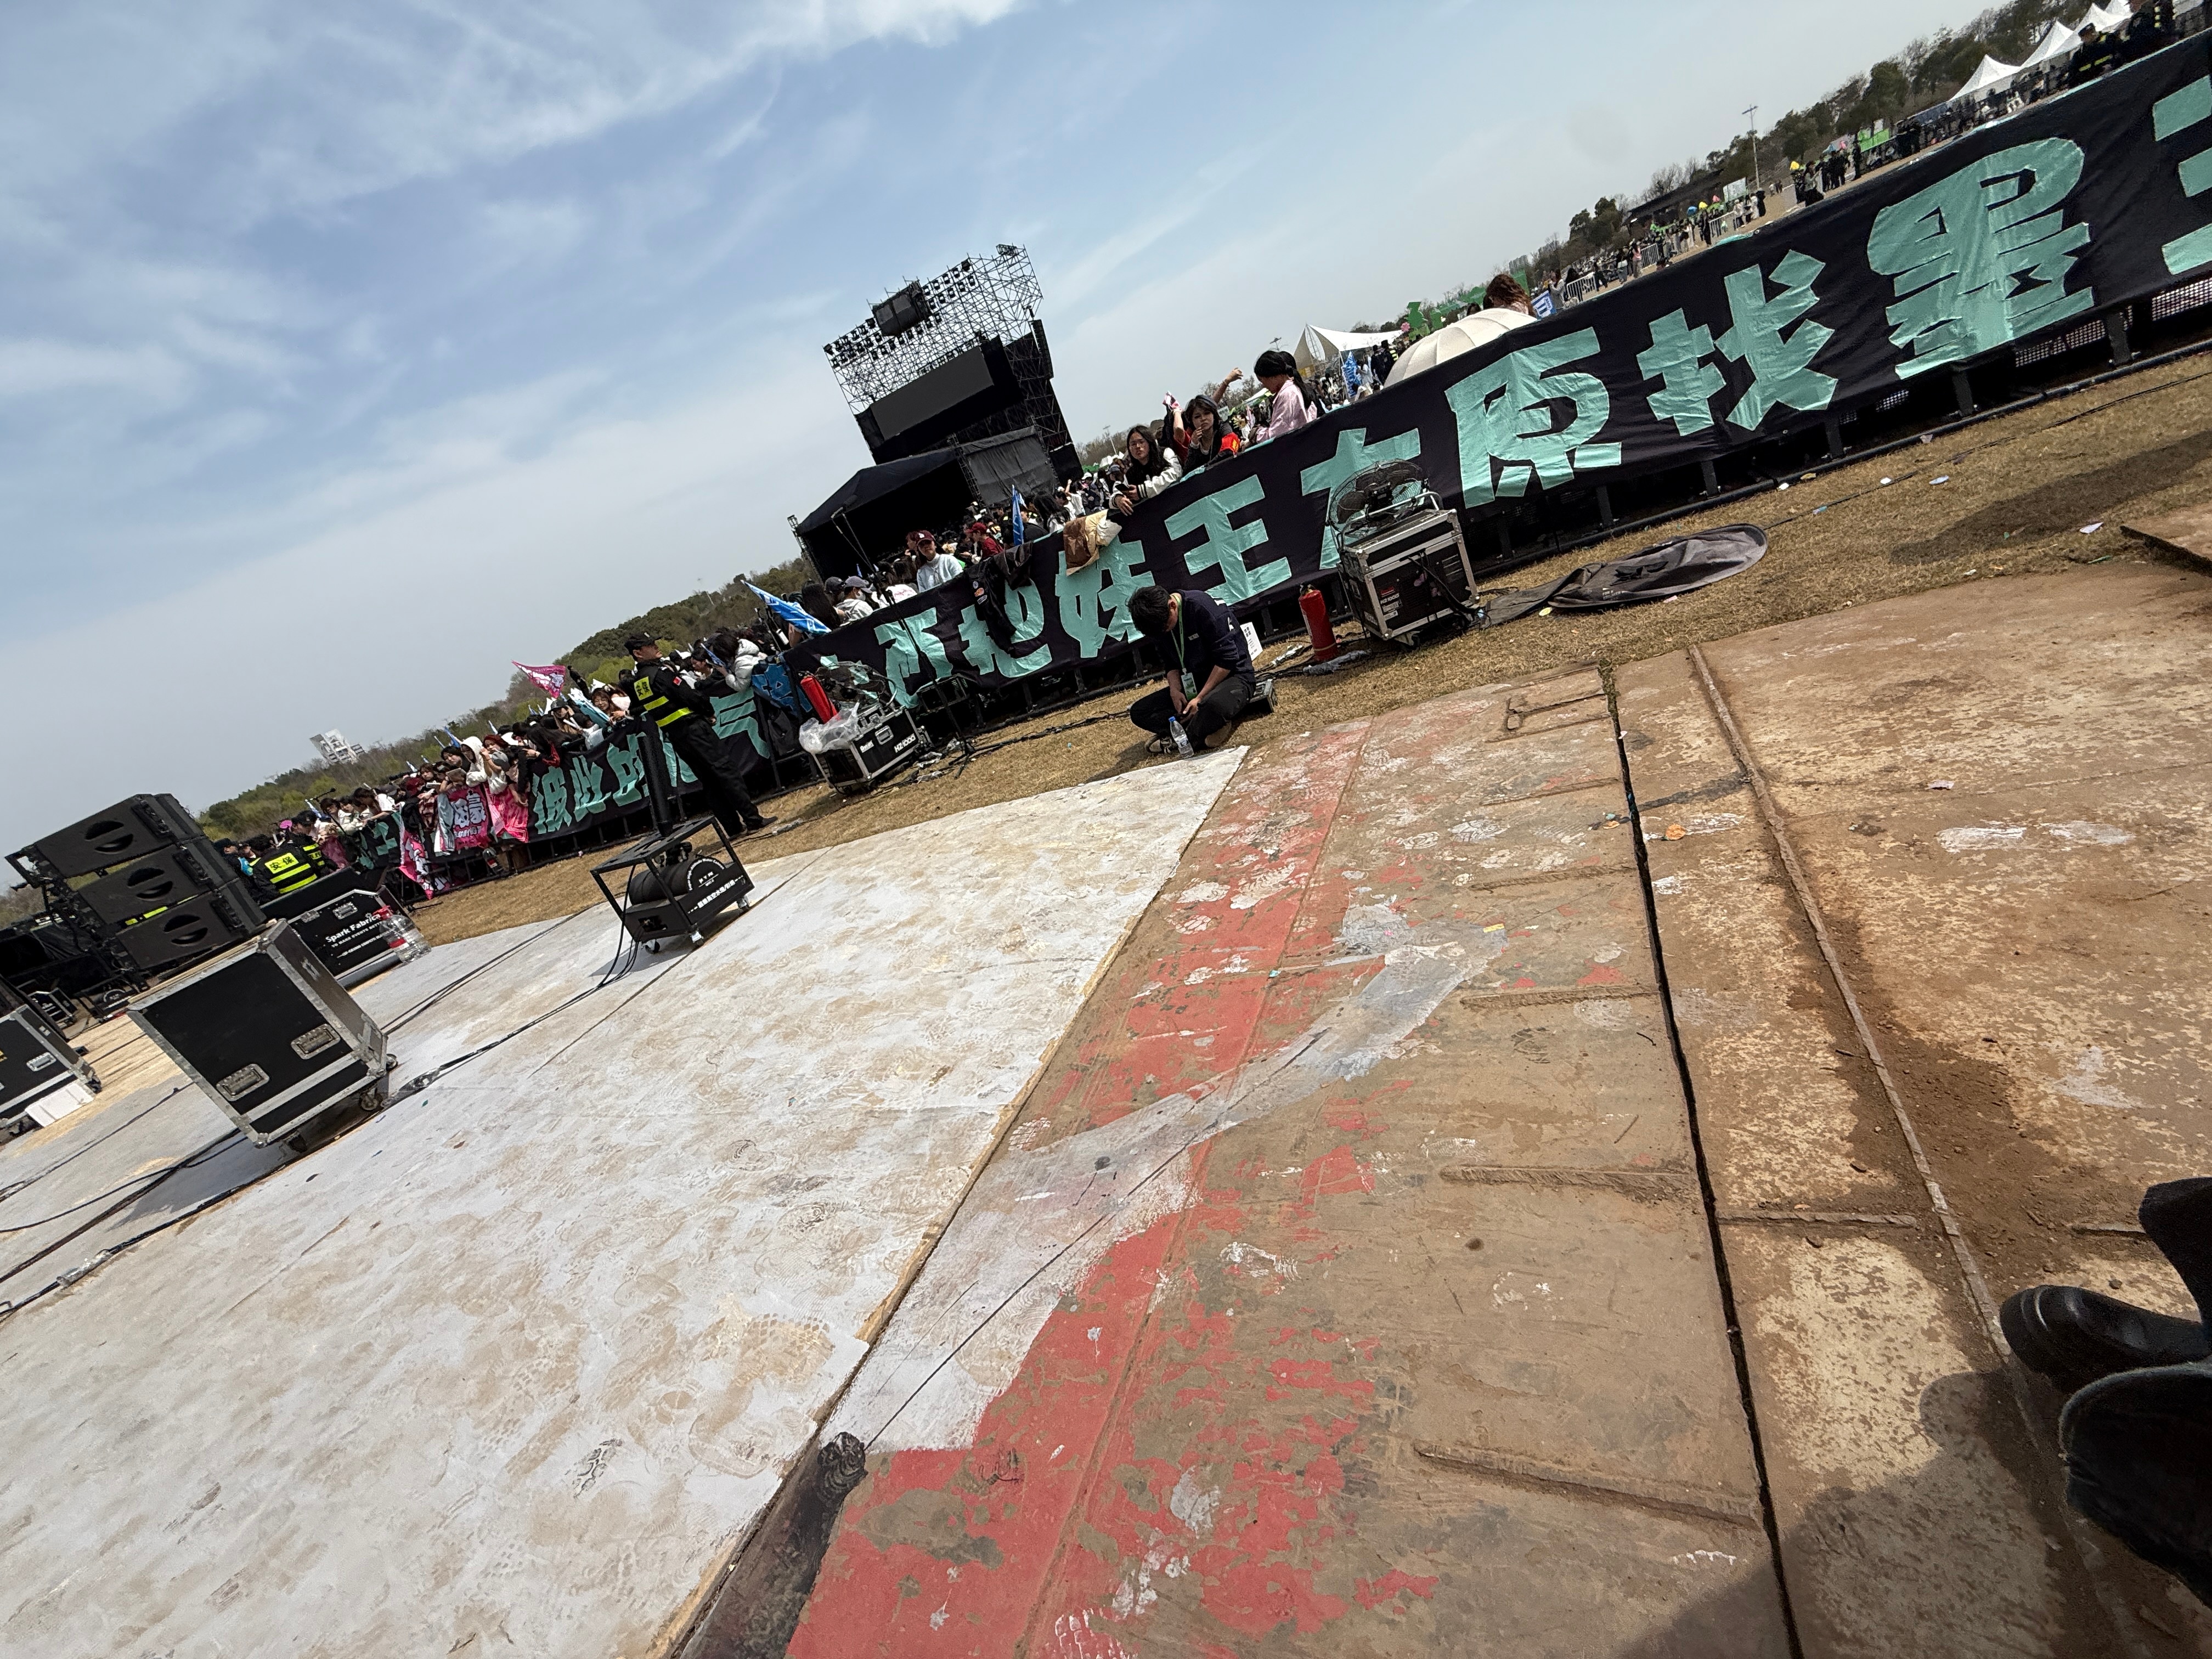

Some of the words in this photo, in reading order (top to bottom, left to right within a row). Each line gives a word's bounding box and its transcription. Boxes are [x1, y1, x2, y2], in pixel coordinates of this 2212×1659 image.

[269, 856, 295, 871] 安保
[325, 929, 351, 943] Spark
[349, 913, 381, 931] Fabrica
